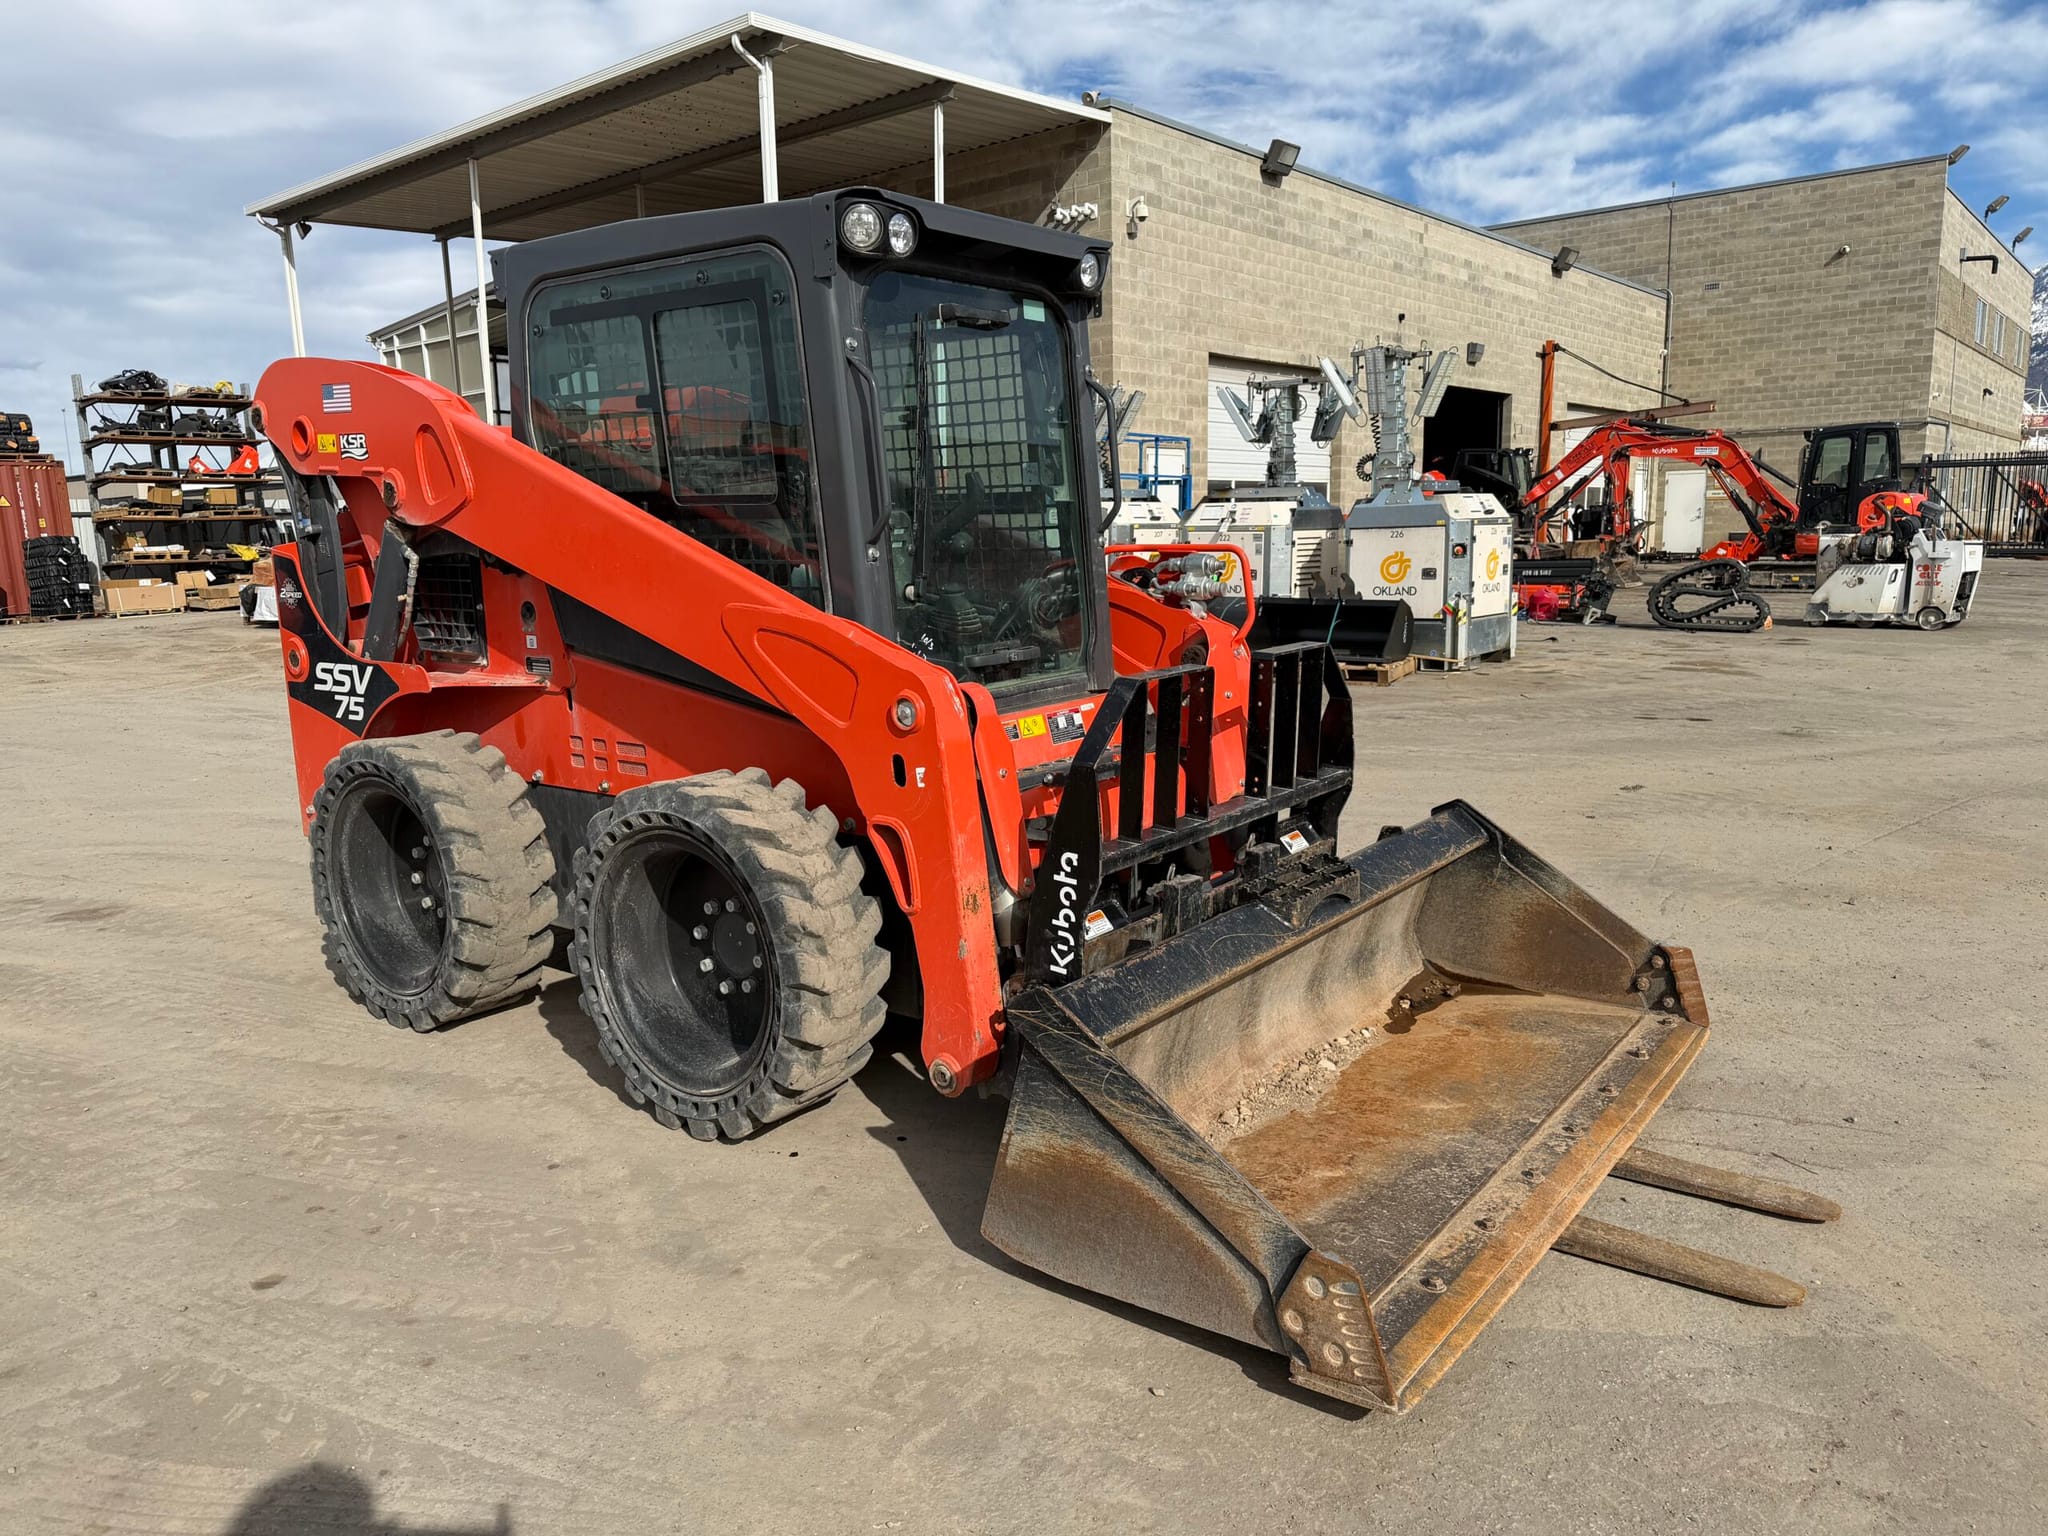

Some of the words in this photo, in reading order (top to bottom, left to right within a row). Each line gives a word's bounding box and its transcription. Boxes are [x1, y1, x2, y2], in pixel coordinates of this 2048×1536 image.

[340, 434, 366, 448] KSR
[1652, 447, 1678, 455] Kubota
[1219, 534, 1231, 542] 222
[1390, 530, 1404, 539] 226
[1372, 586, 1417, 596] OKLAND
[1482, 582, 1501, 594] OKLAND
[314, 661, 374, 695] SSV
[334, 695, 365, 721] 75
[1049, 851, 1079, 975] Kubota
